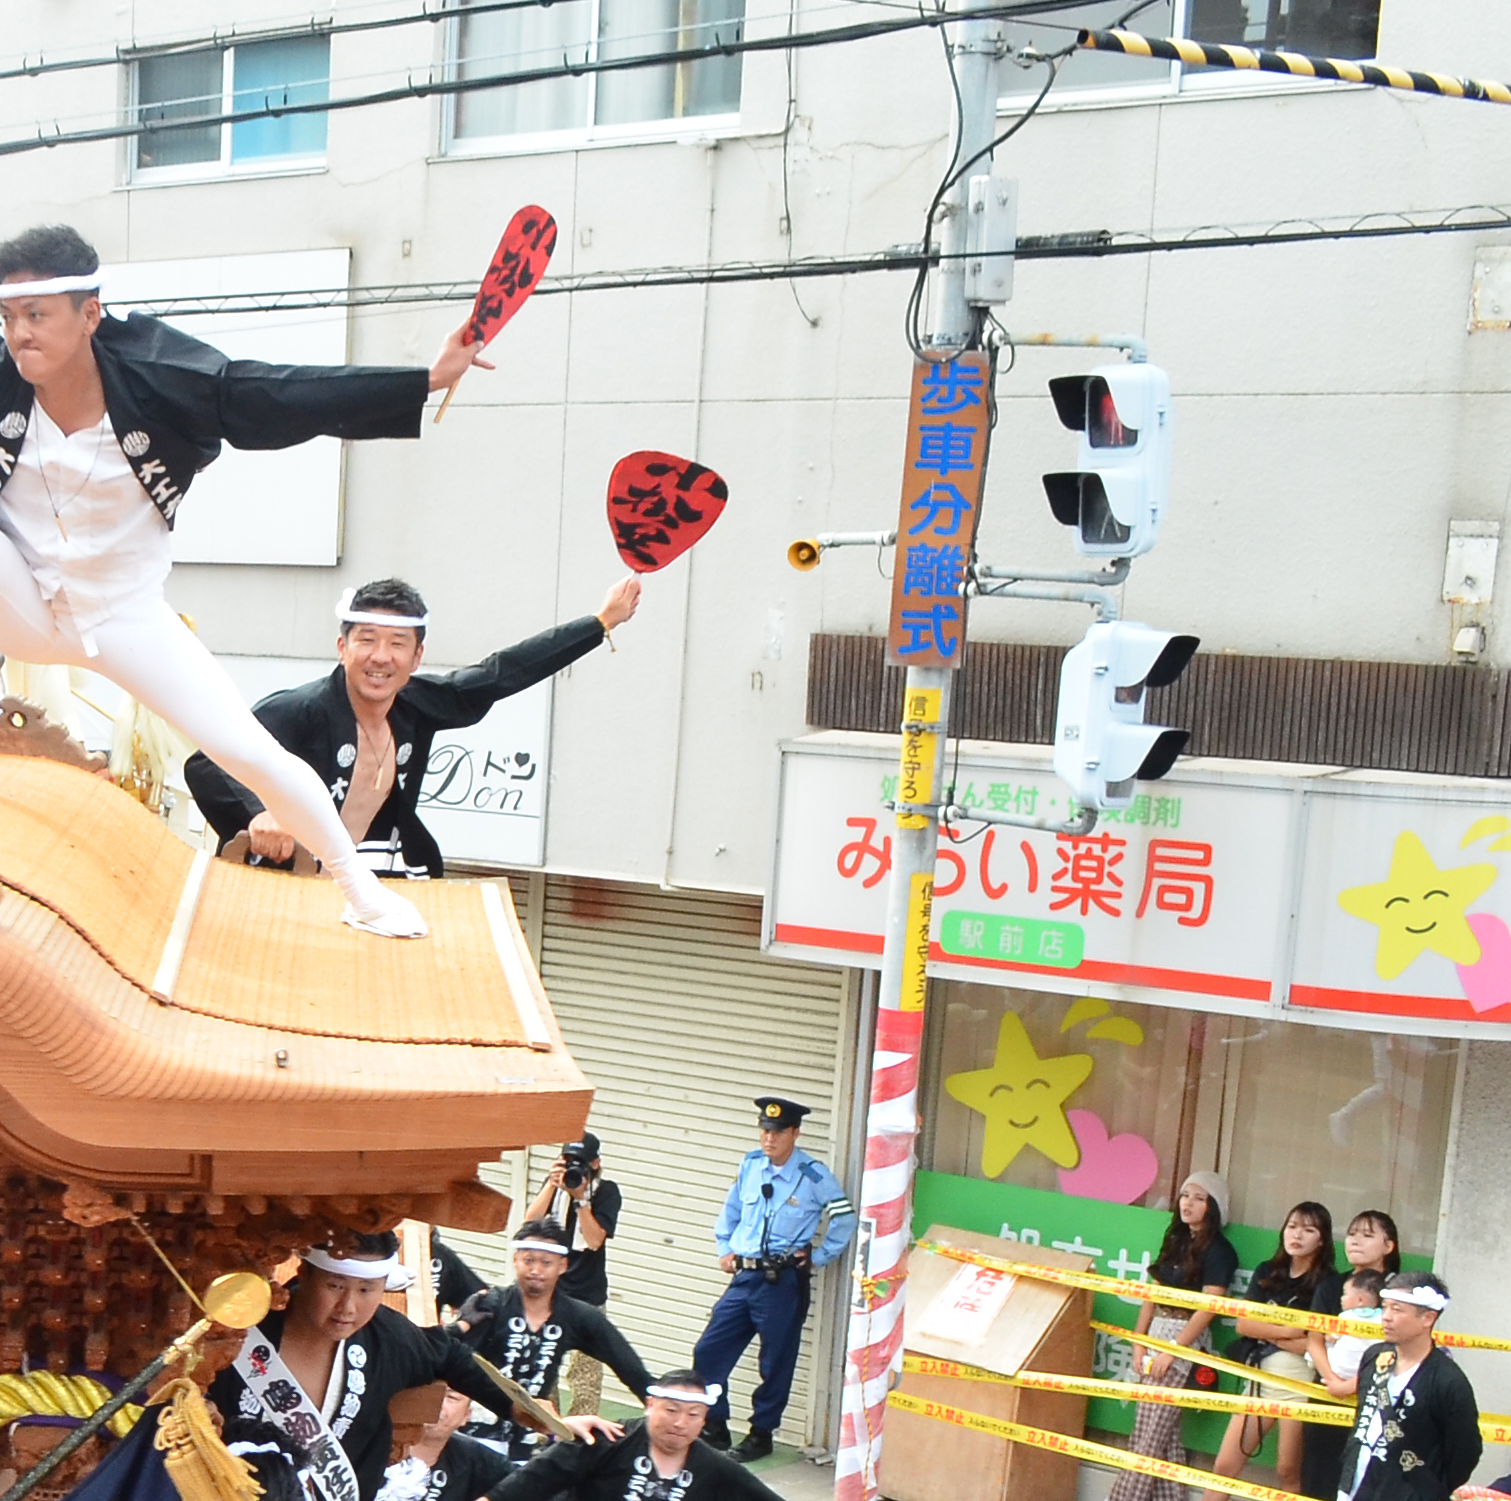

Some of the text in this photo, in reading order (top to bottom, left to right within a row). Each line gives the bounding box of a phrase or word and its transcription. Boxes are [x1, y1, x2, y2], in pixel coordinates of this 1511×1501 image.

[896, 360, 984, 660] 歩車分離式
[416, 744, 524, 812] Don
[836, 814, 1215, 928] みらい薬局
[959, 918, 1067, 961] 駅前店
[1113, 1280, 1153, 1300] 立入禁止
[1207, 1298, 1248, 1318] 立入禁止
[1306, 1313, 1350, 1336] 立入禁止
[1431, 1332, 1467, 1348] 入禁止
[919, 1359, 960, 1378] 立入禁止
[1020, 1373, 1065, 1391] 立入禁止
[1129, 1385, 1176, 1404] 立入禁止
[1243, 1400, 1293, 1418] 立入禁止
[923, 1402, 966, 1426] 立入禁止
[967, 1415, 1022, 1438] 入らないでください
[1026, 1429, 1071, 1453] 立入禁止
[1072, 1442, 1130, 1465] 入らないでください
[1132, 1457, 1181, 1480] 立入禁止
